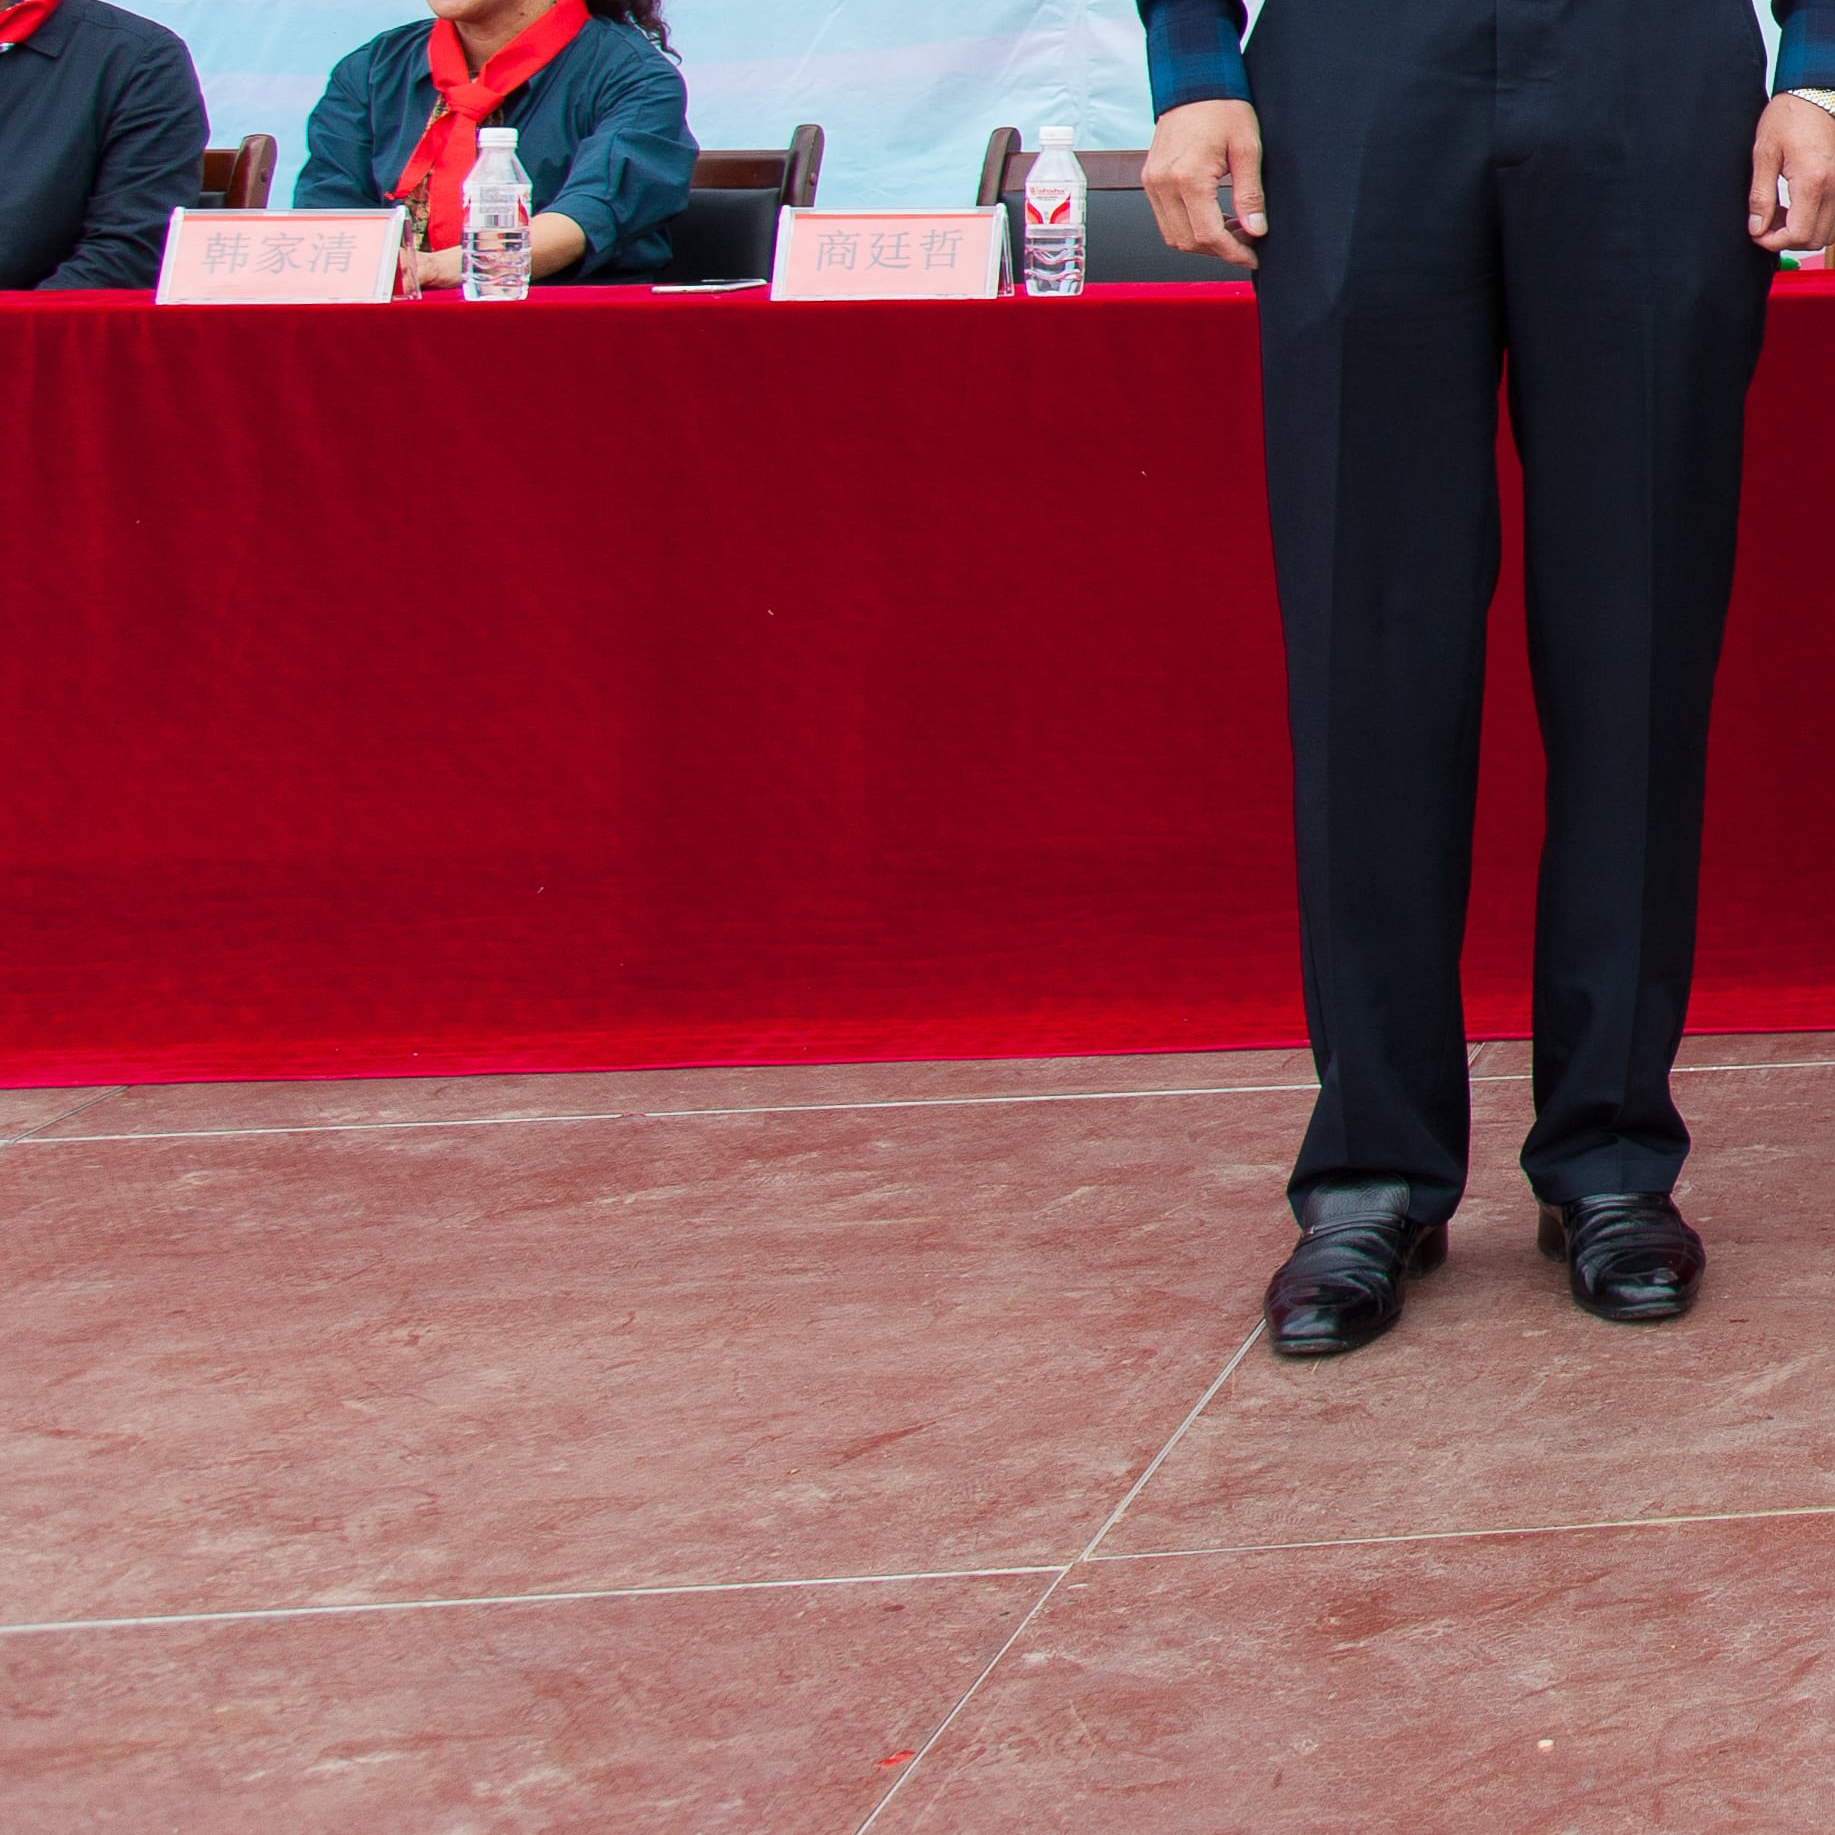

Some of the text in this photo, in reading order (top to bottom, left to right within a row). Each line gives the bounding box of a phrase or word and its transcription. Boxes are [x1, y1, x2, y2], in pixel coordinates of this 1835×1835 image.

[200, 231, 359, 276] 韩家清
[815, 228, 965, 272] 商廷哲
